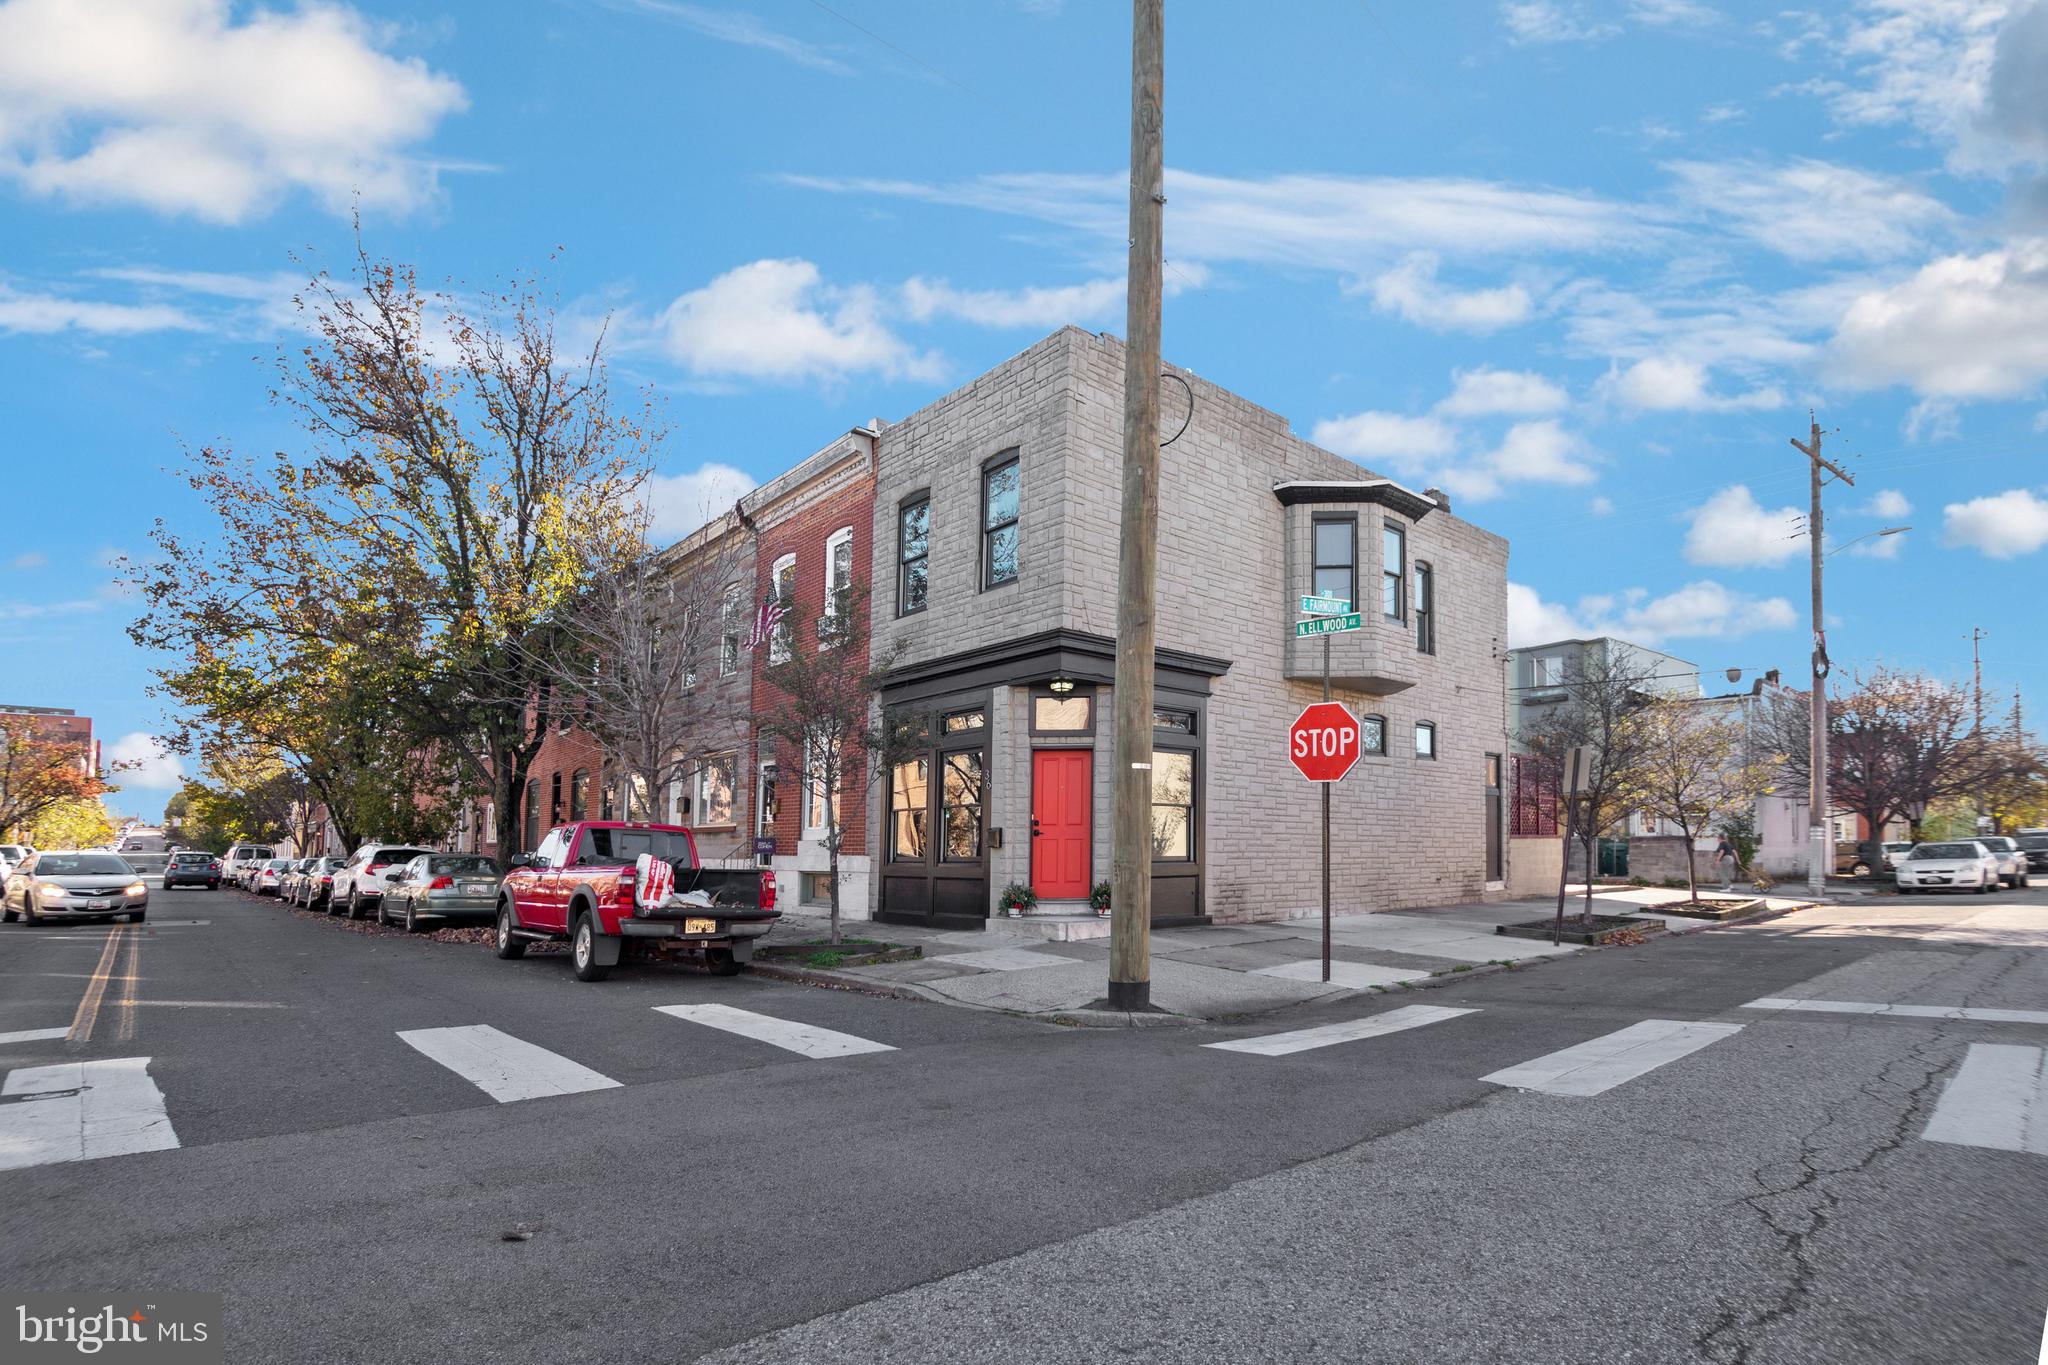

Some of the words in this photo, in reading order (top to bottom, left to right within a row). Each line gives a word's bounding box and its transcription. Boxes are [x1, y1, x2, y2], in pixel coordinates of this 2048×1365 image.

[1303, 598, 1308, 610] E
[1310, 599, 1342, 614] FAIRMOUNT
[1299, 623, 1307, 635] N.
[1308, 617, 1347, 634] ELLWOOD
[1294, 727, 1355, 758] STOP
